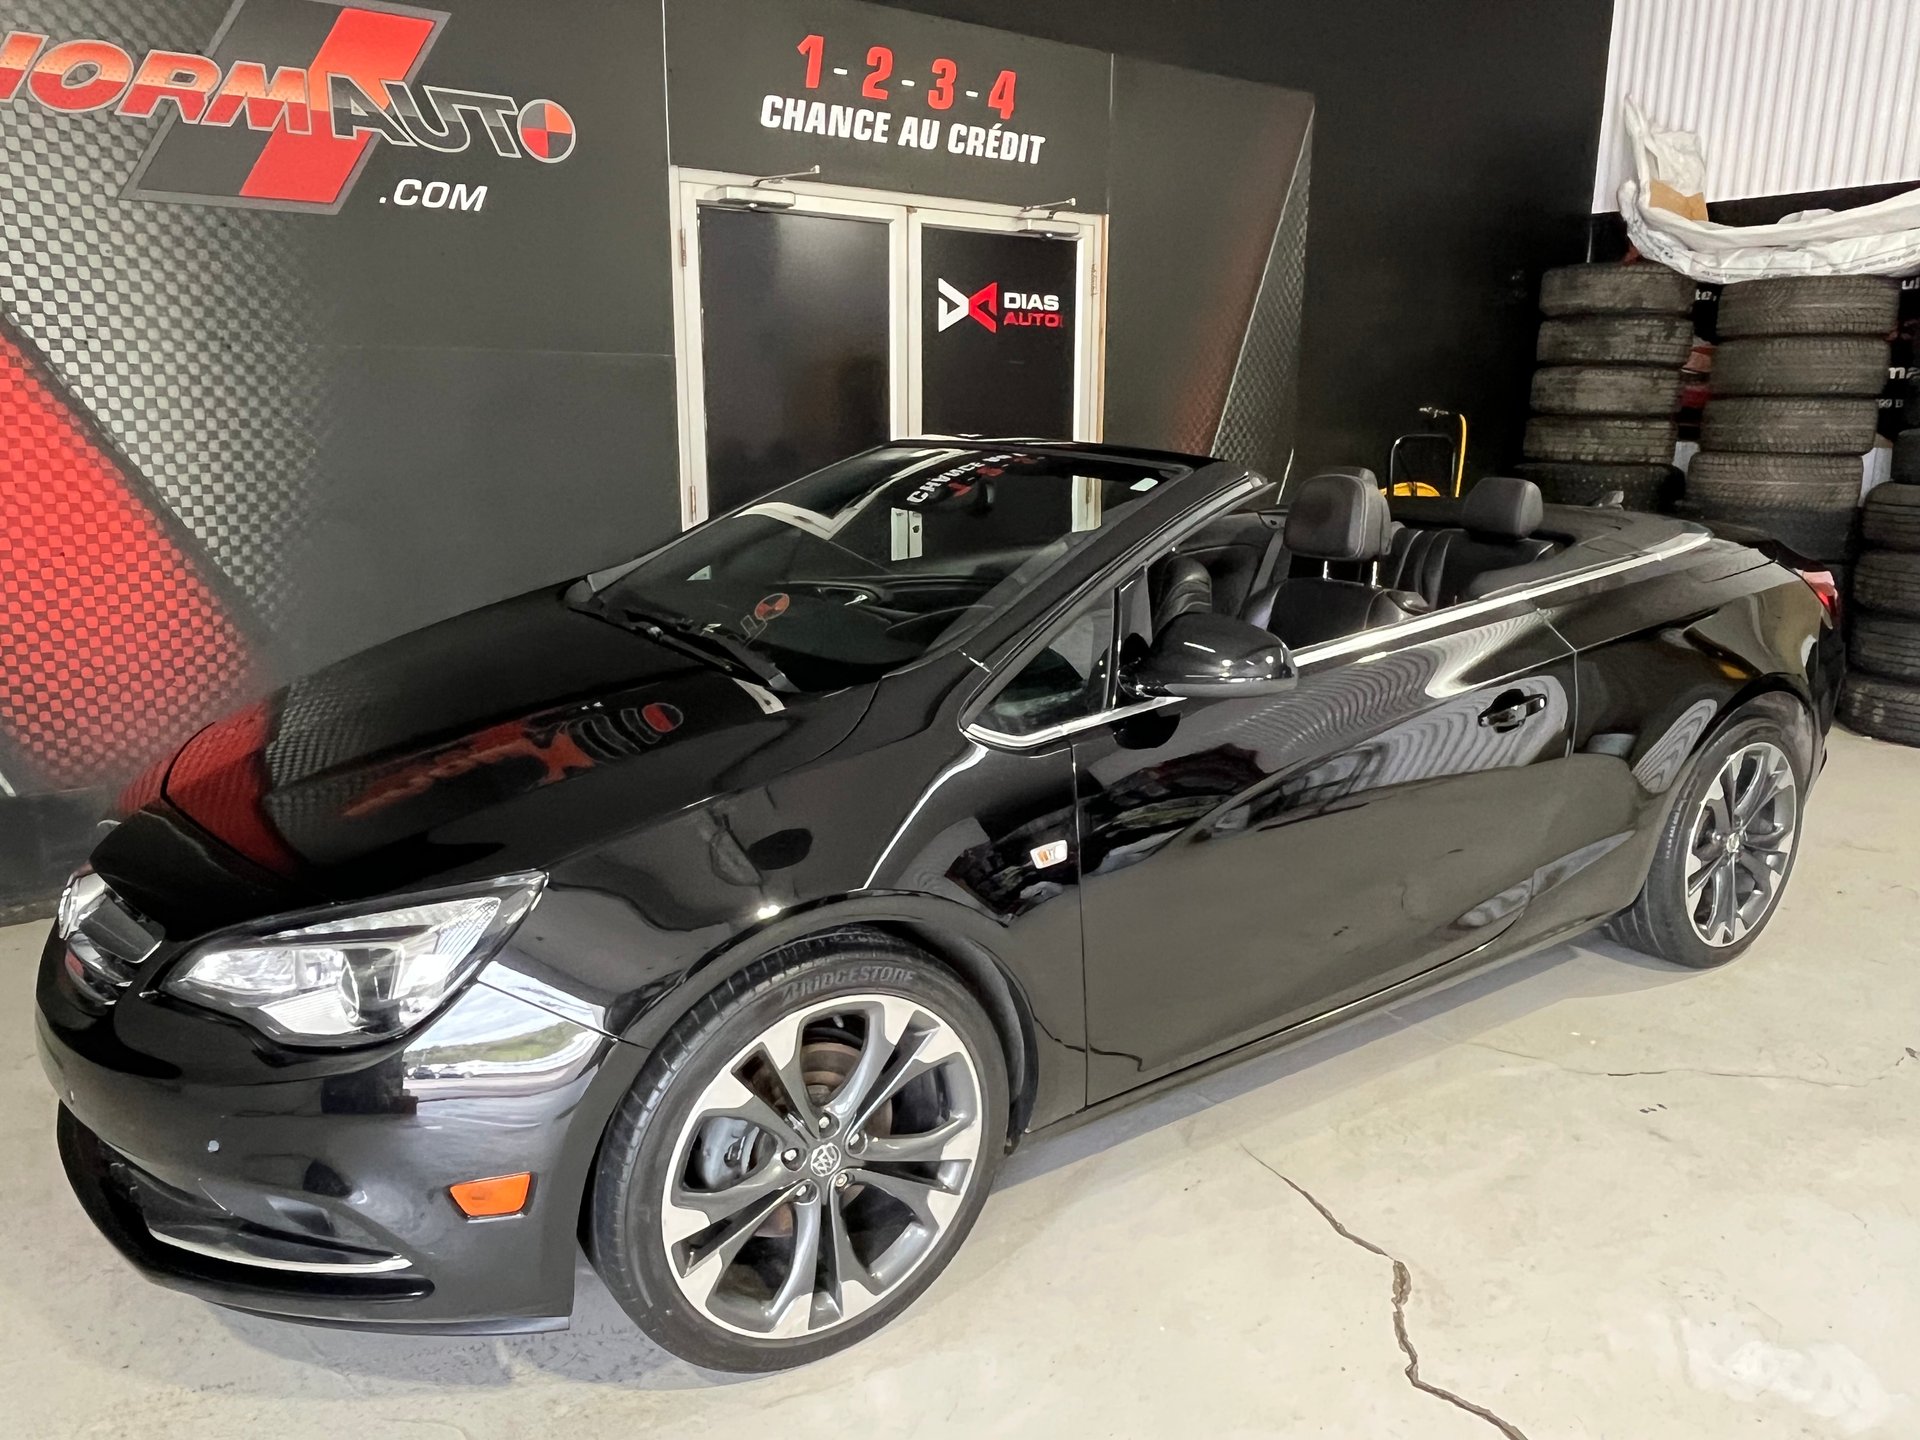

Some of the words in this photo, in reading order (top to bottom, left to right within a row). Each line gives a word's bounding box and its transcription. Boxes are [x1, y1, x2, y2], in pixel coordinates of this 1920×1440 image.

[760, 94, 891, 144] CHANCE
[897, 116, 941, 150] AU
[947, 123, 1046, 165] CRÉDIT
[379, 178, 488, 212] .COM
[1004, 292, 1060, 311] DIAS
[1003, 311, 1060, 328] AUTO
